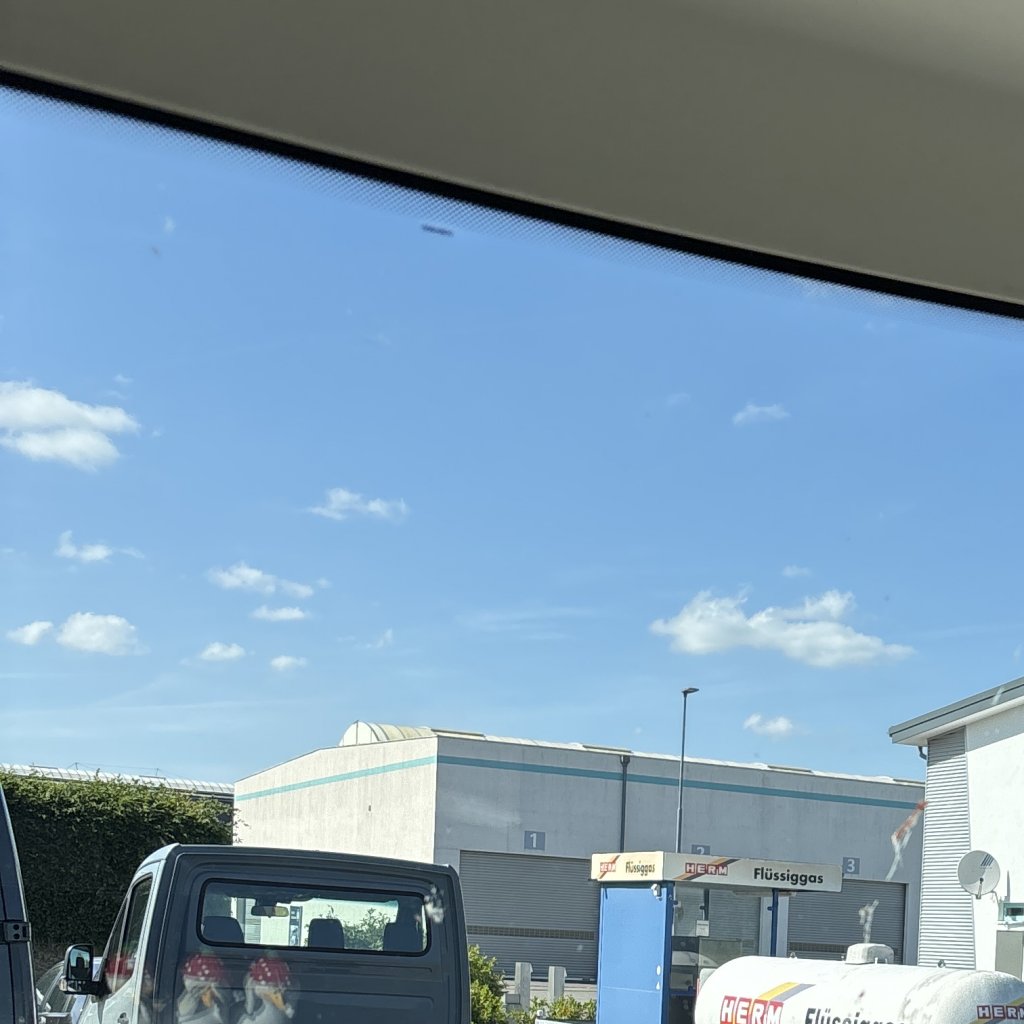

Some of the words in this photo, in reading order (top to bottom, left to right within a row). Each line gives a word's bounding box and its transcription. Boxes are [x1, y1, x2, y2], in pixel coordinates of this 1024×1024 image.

[530, 833, 537, 848] 1
[625, 860, 655, 876] Flüssiggas
[847, 859, 855, 872] 3
[686, 863, 728, 876] HERM
[753, 867, 823, 886] Flüssiggas
